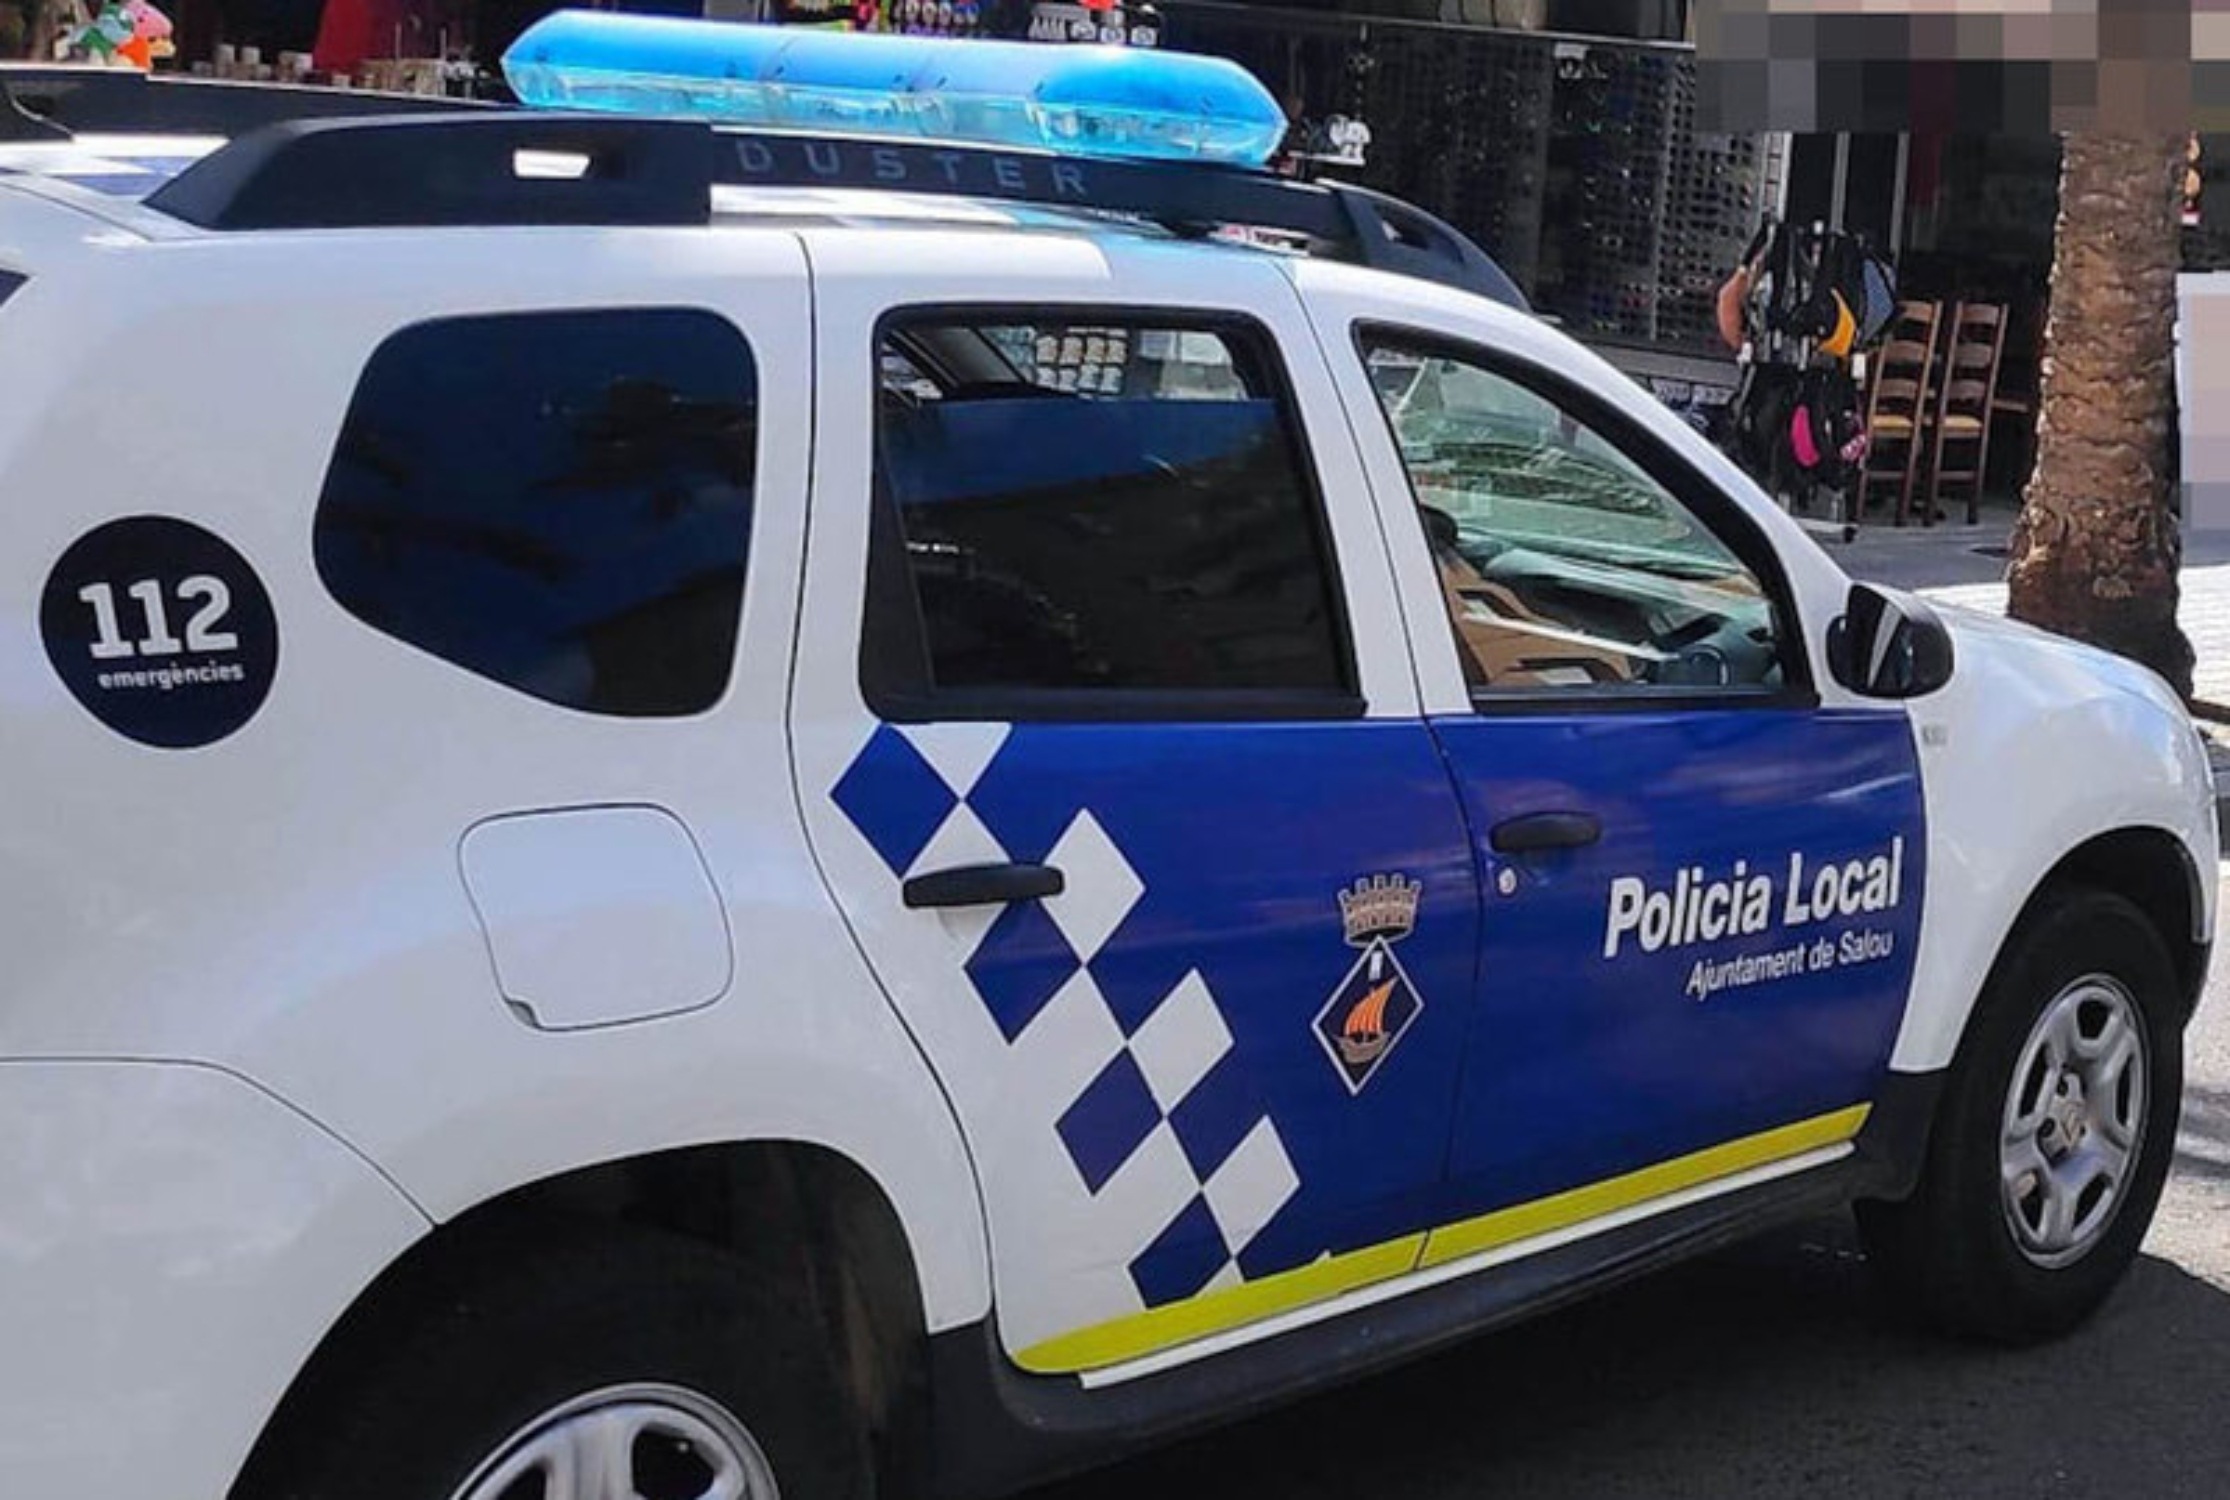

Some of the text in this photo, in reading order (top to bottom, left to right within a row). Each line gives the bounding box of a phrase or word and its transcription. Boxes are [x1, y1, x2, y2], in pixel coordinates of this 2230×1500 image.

[735, 138, 1086, 195] DUSTER
[78, 574, 238, 658] 112
[1604, 836, 1902, 958] Policia Local
[1686, 929, 1893, 1001] Ajuntament de Salou
